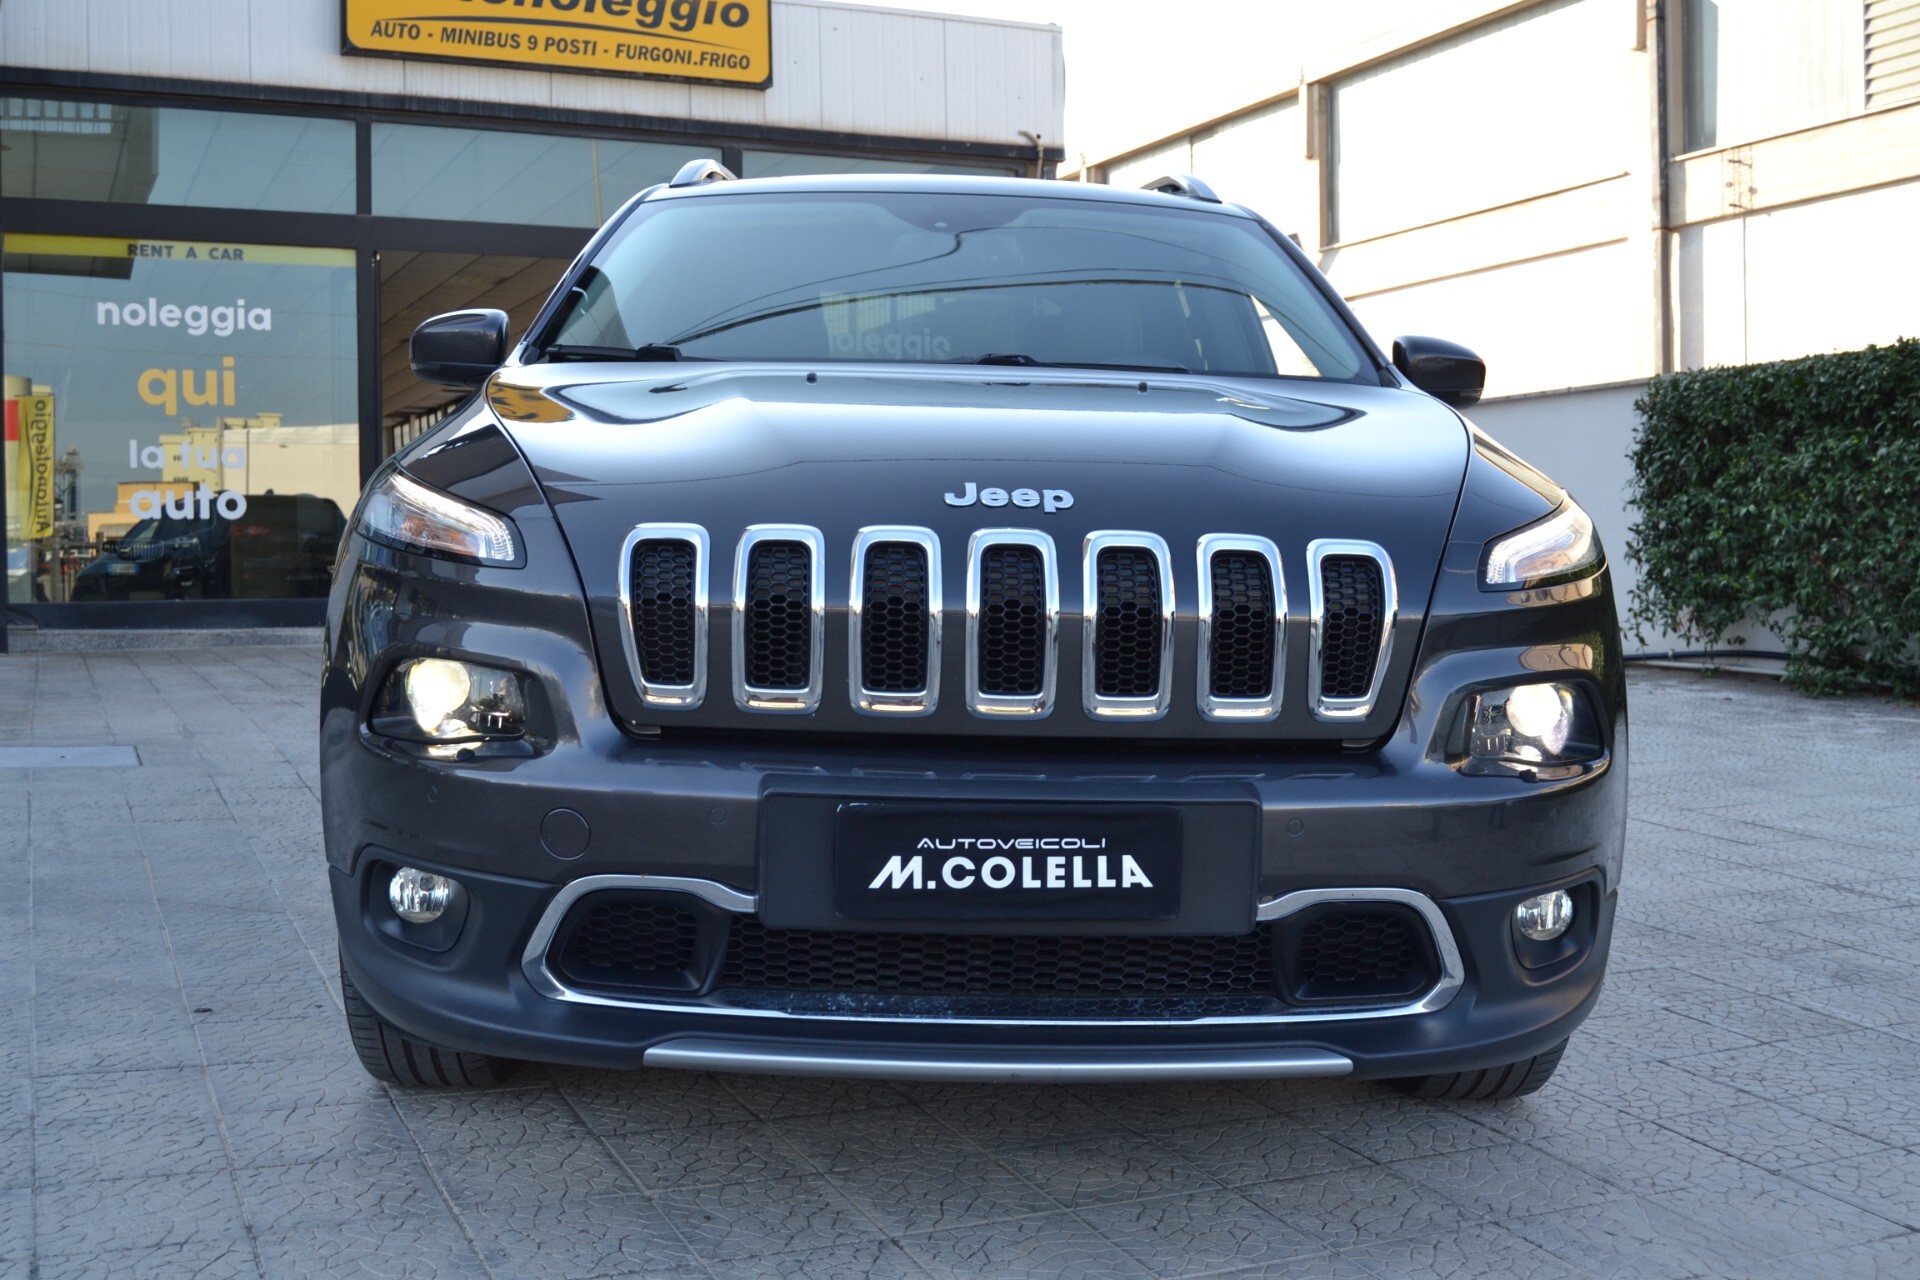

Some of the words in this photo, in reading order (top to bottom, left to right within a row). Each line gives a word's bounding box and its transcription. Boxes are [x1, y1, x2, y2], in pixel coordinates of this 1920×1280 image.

[371, 20, 421, 40] AUTO
[440, 27, 521, 49] MINIBUS
[527, 35, 538, 51] 9
[544, 36, 597, 56] POSTI
[128, 244, 174, 258] RENT
[186, 246, 197, 259] A
[209, 247, 244, 261] CAR
[97, 297, 271, 337] noleggia
[138, 356, 236, 416] qui
[129, 439, 164, 469] la
[179, 440, 245, 469] tua
[130, 484, 247, 520] auto
[944, 482, 1074, 513] Jeep
[917, 837, 1106, 849] AUTOVEICOLI
[868, 855, 1154, 889] M.COLELLA
